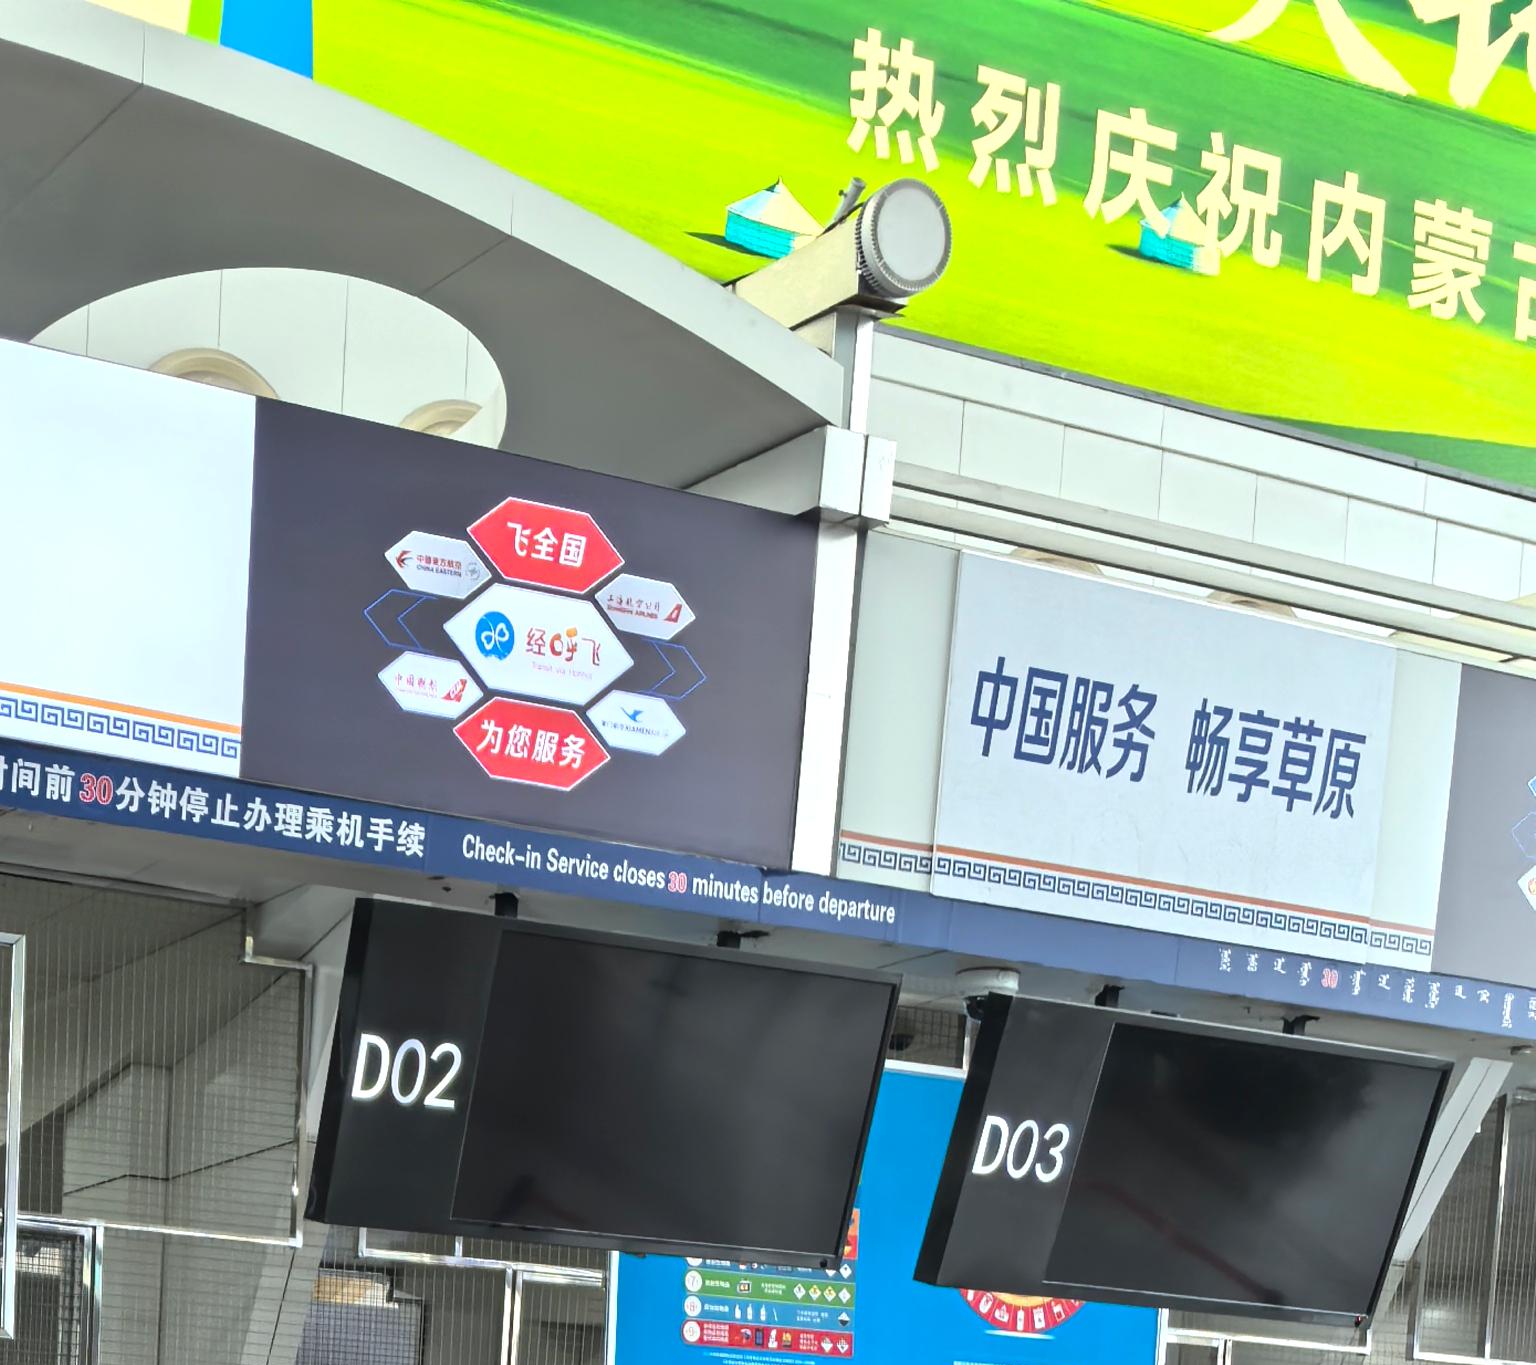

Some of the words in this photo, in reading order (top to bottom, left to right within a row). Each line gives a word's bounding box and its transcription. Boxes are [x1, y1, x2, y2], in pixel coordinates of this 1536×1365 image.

[506, 520, 587, 568] 飞全国
[475, 719, 586, 769] 为您服务
[970, 656, 1158, 783] 中国服务
[1184, 698, 1368, 820] 畅享草原
[461, 833, 542, 871] Check-in
[546, 847, 609, 881] Service
[612, 859, 665, 889] closes
[667, 870, 688, 894] 30
[692, 875, 759, 906] minutes
[762, 881, 814, 913] before
[818, 890, 897, 924] departure
[351, 1033, 463, 1109] D02
[970, 1113, 1071, 1183] D03
